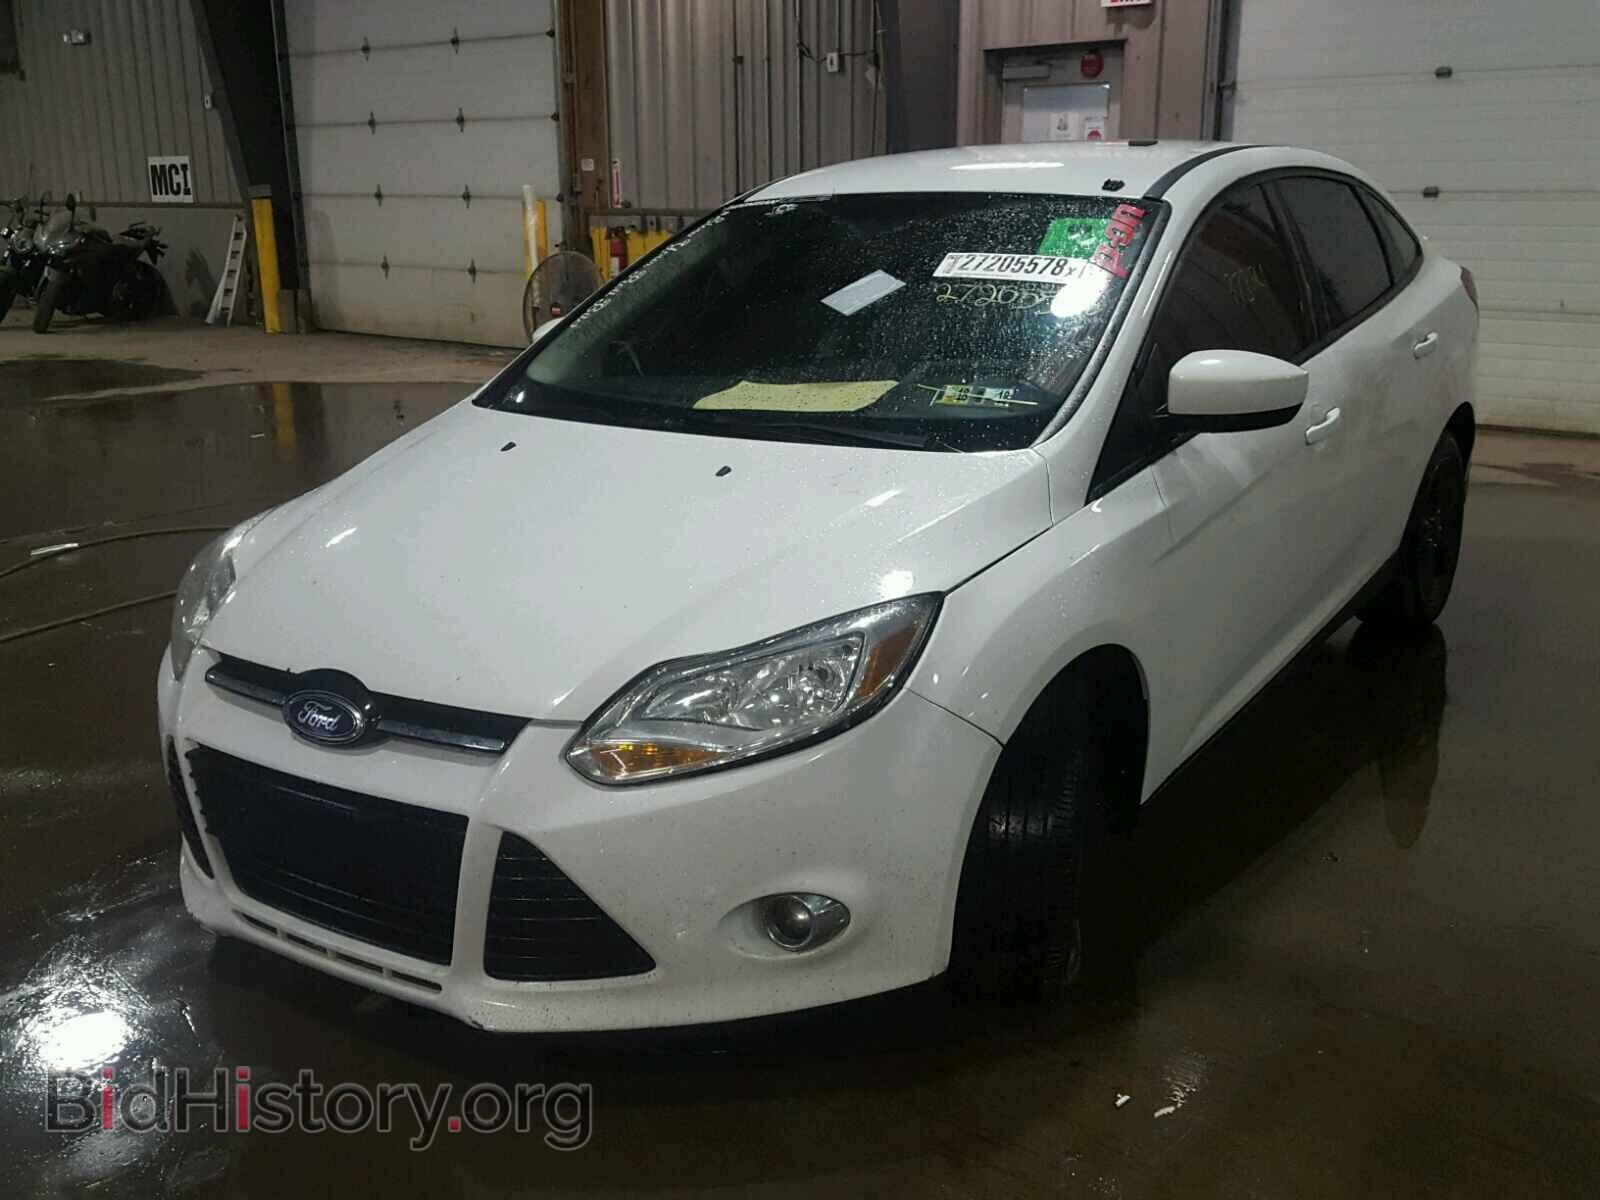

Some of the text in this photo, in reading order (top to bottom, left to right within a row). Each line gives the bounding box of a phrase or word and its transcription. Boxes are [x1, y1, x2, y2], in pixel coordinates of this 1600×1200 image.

[150, 164, 191, 196] MCI
[957, 254, 1069, 277] 27205578
[297, 700, 341, 732] Ford
